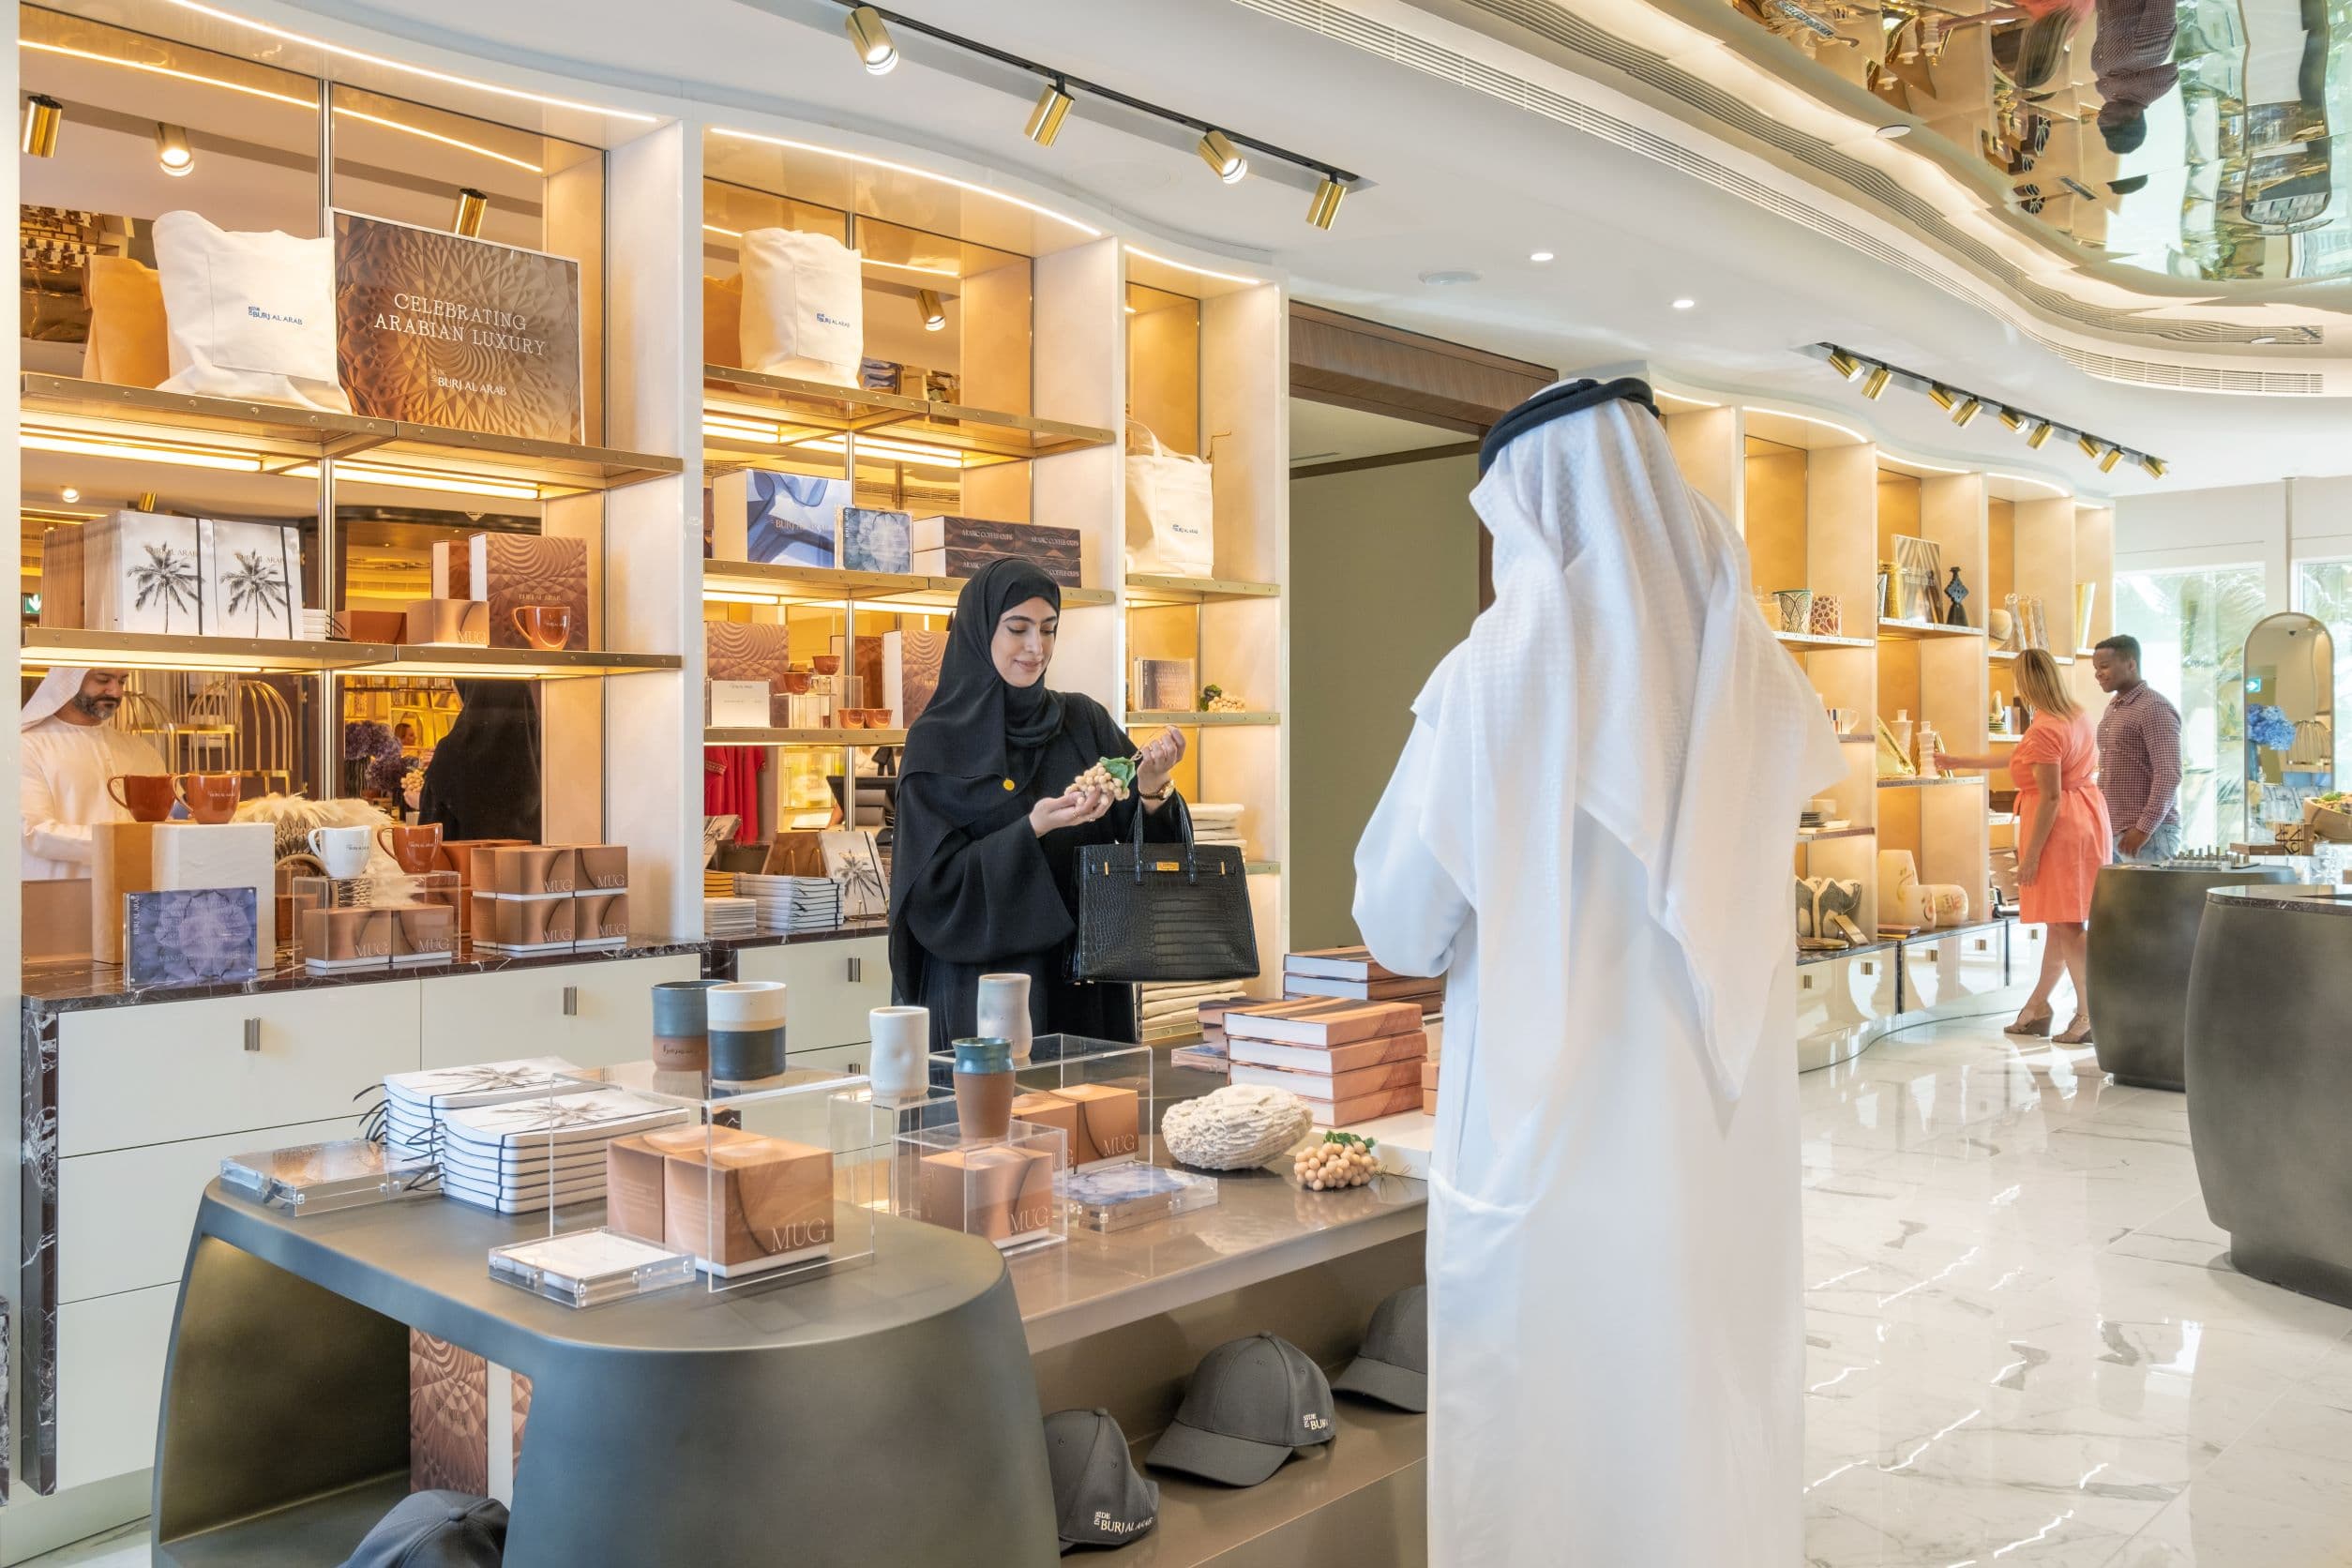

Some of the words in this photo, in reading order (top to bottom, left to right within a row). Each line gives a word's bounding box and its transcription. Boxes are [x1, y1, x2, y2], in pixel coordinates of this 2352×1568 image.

[394, 293, 526, 331] CELEBRATING
[374, 312, 464, 342] ARABIAN
[472, 329, 546, 356] LUXURY
[438, 376, 462, 391] BURJ
[464, 382, 478, 392] AL
[479, 384, 507, 397] ARAB
[457, 629, 487, 645] MUG
[545, 880, 573, 893] MUG
[597, 874, 625, 888] MUG
[544, 929, 572, 942] MUG
[600, 923, 627, 937] MUG
[354, 942, 388, 957] MUG
[419, 937, 450, 952] MUG
[1103, 1134, 1136, 1157] MUG
[1011, 1206, 1049, 1233] MUG
[770, 1217, 826, 1253] MUG
[1101, 1519, 1124, 1535] BURJ
[1124, 1521, 1135, 1533] AL
